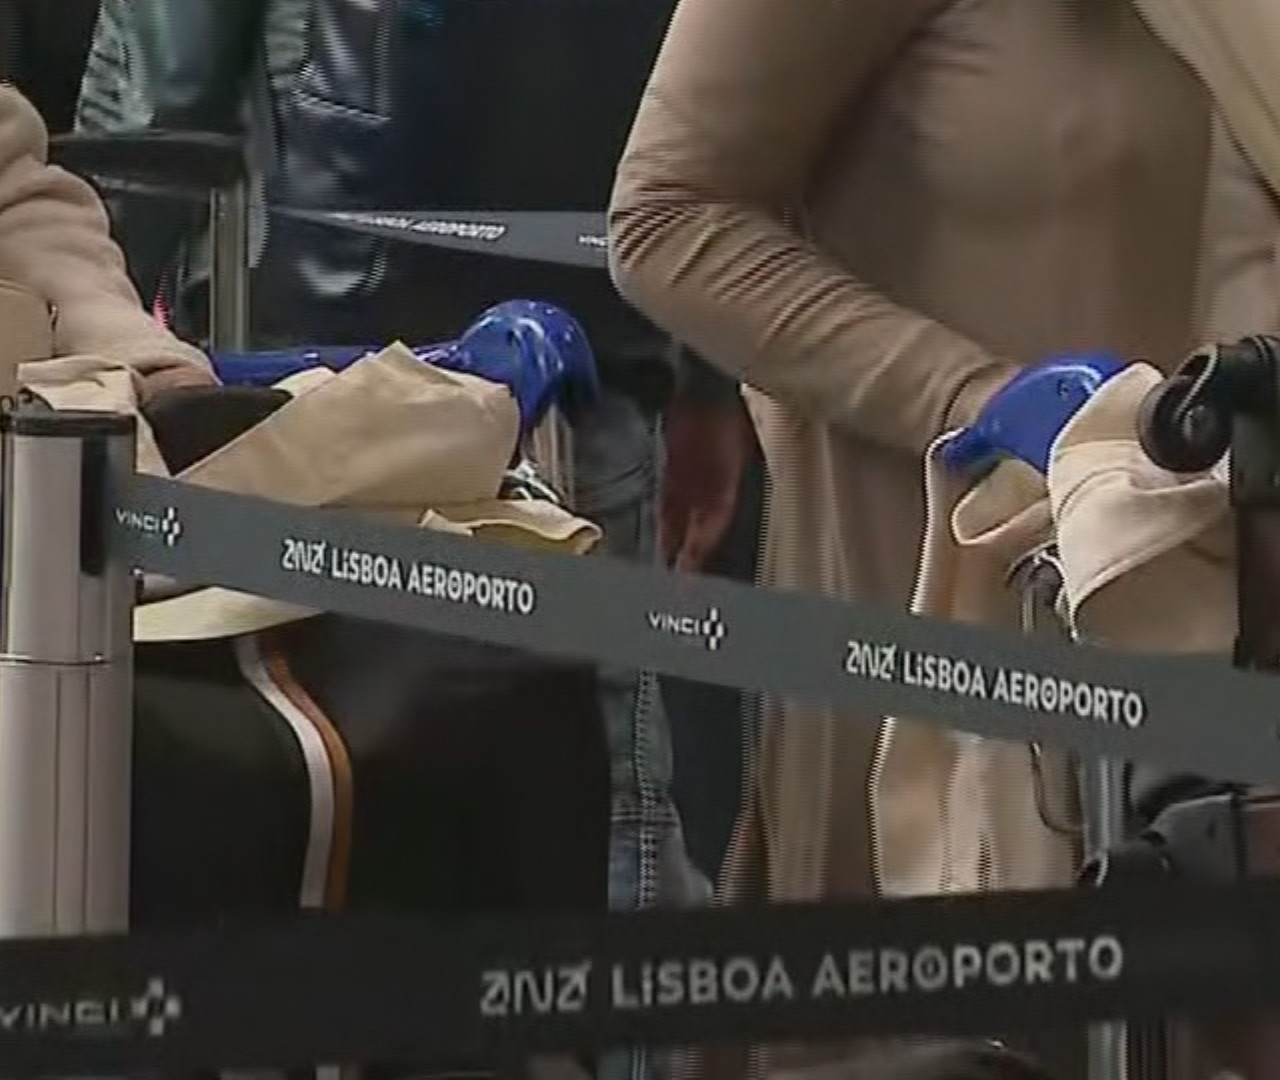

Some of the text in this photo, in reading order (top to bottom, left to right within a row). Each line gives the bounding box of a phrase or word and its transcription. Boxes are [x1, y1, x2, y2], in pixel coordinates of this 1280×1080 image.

[115, 507, 160, 531] VINCI
[406, 561, 533, 614] AEROPORTO
[649, 610, 699, 635] VINCI
[993, 667, 1143, 726] AEROPORTO
[812, 936, 1124, 997] AEROPORTO
